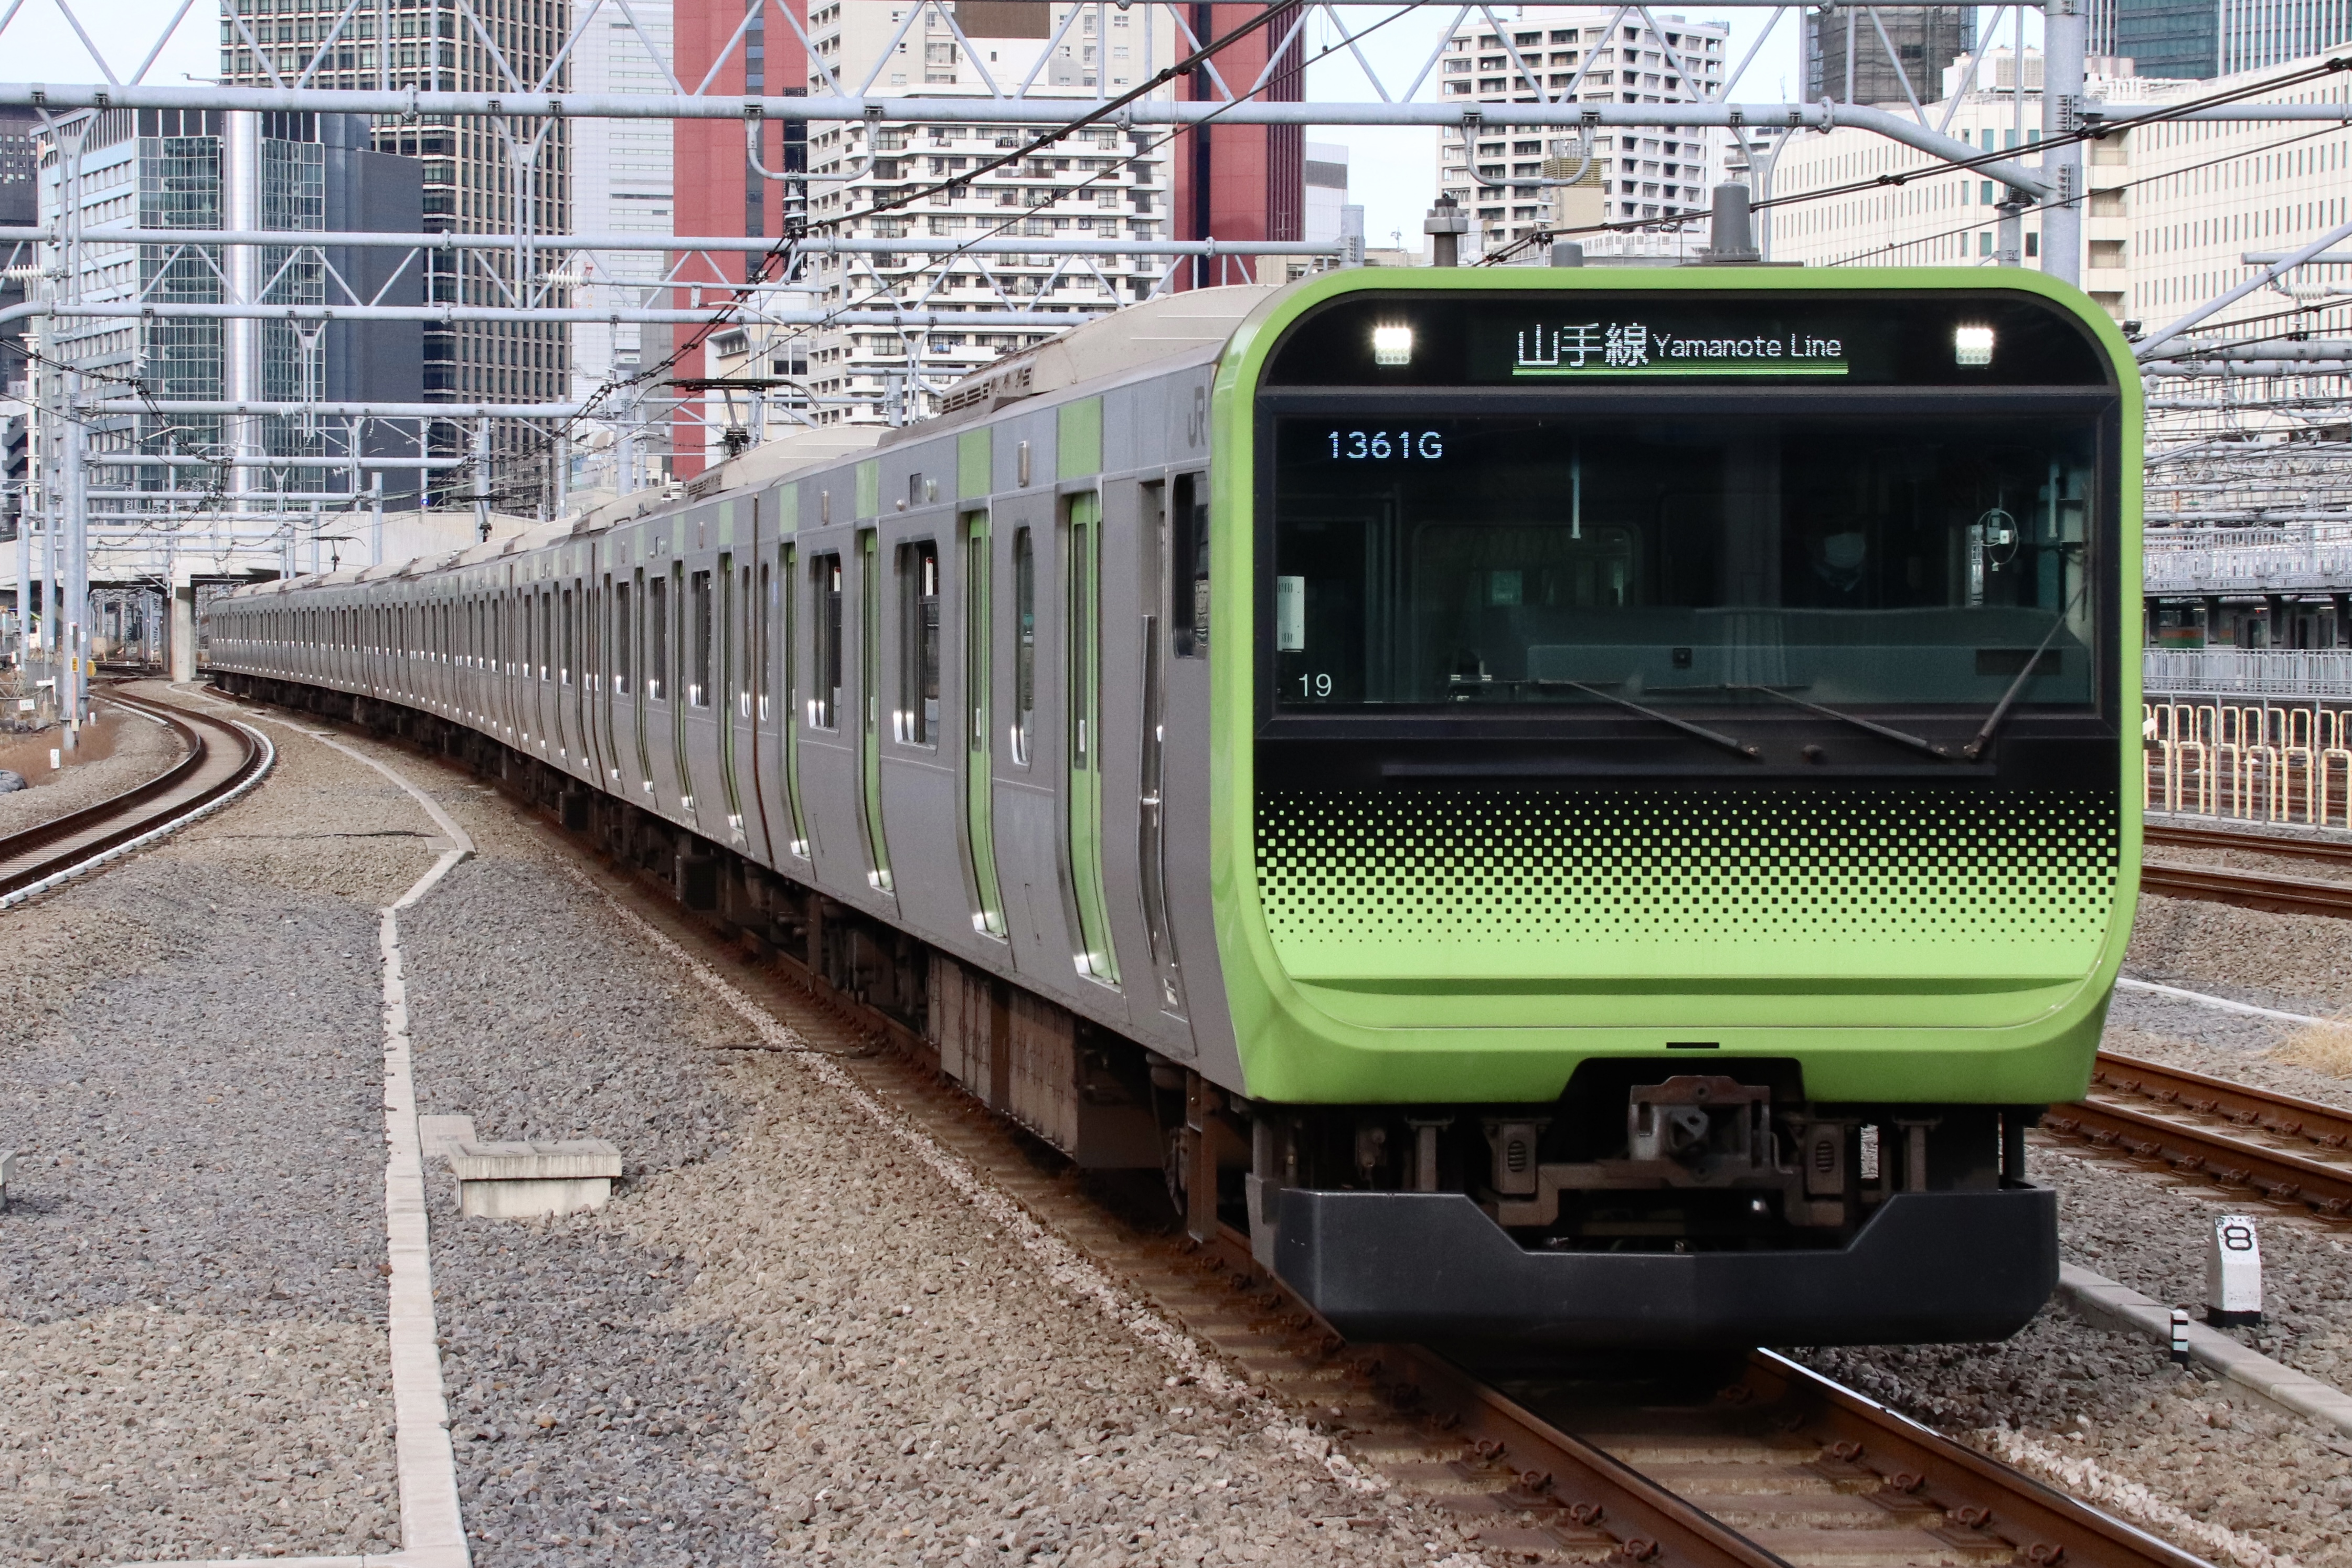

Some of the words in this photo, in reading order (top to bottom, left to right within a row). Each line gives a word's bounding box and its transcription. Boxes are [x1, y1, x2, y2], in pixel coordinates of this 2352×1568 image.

[1518, 323, 1649, 366] 山手線
[1653, 334, 1782, 358] Yamanote
[1791, 333, 1842, 357] Line
[1188, 386, 1205, 448] JR
[1328, 431, 1442, 458] 1361G
[1299, 674, 1332, 697] 19
[2225, 1226, 2252, 1251] 8
